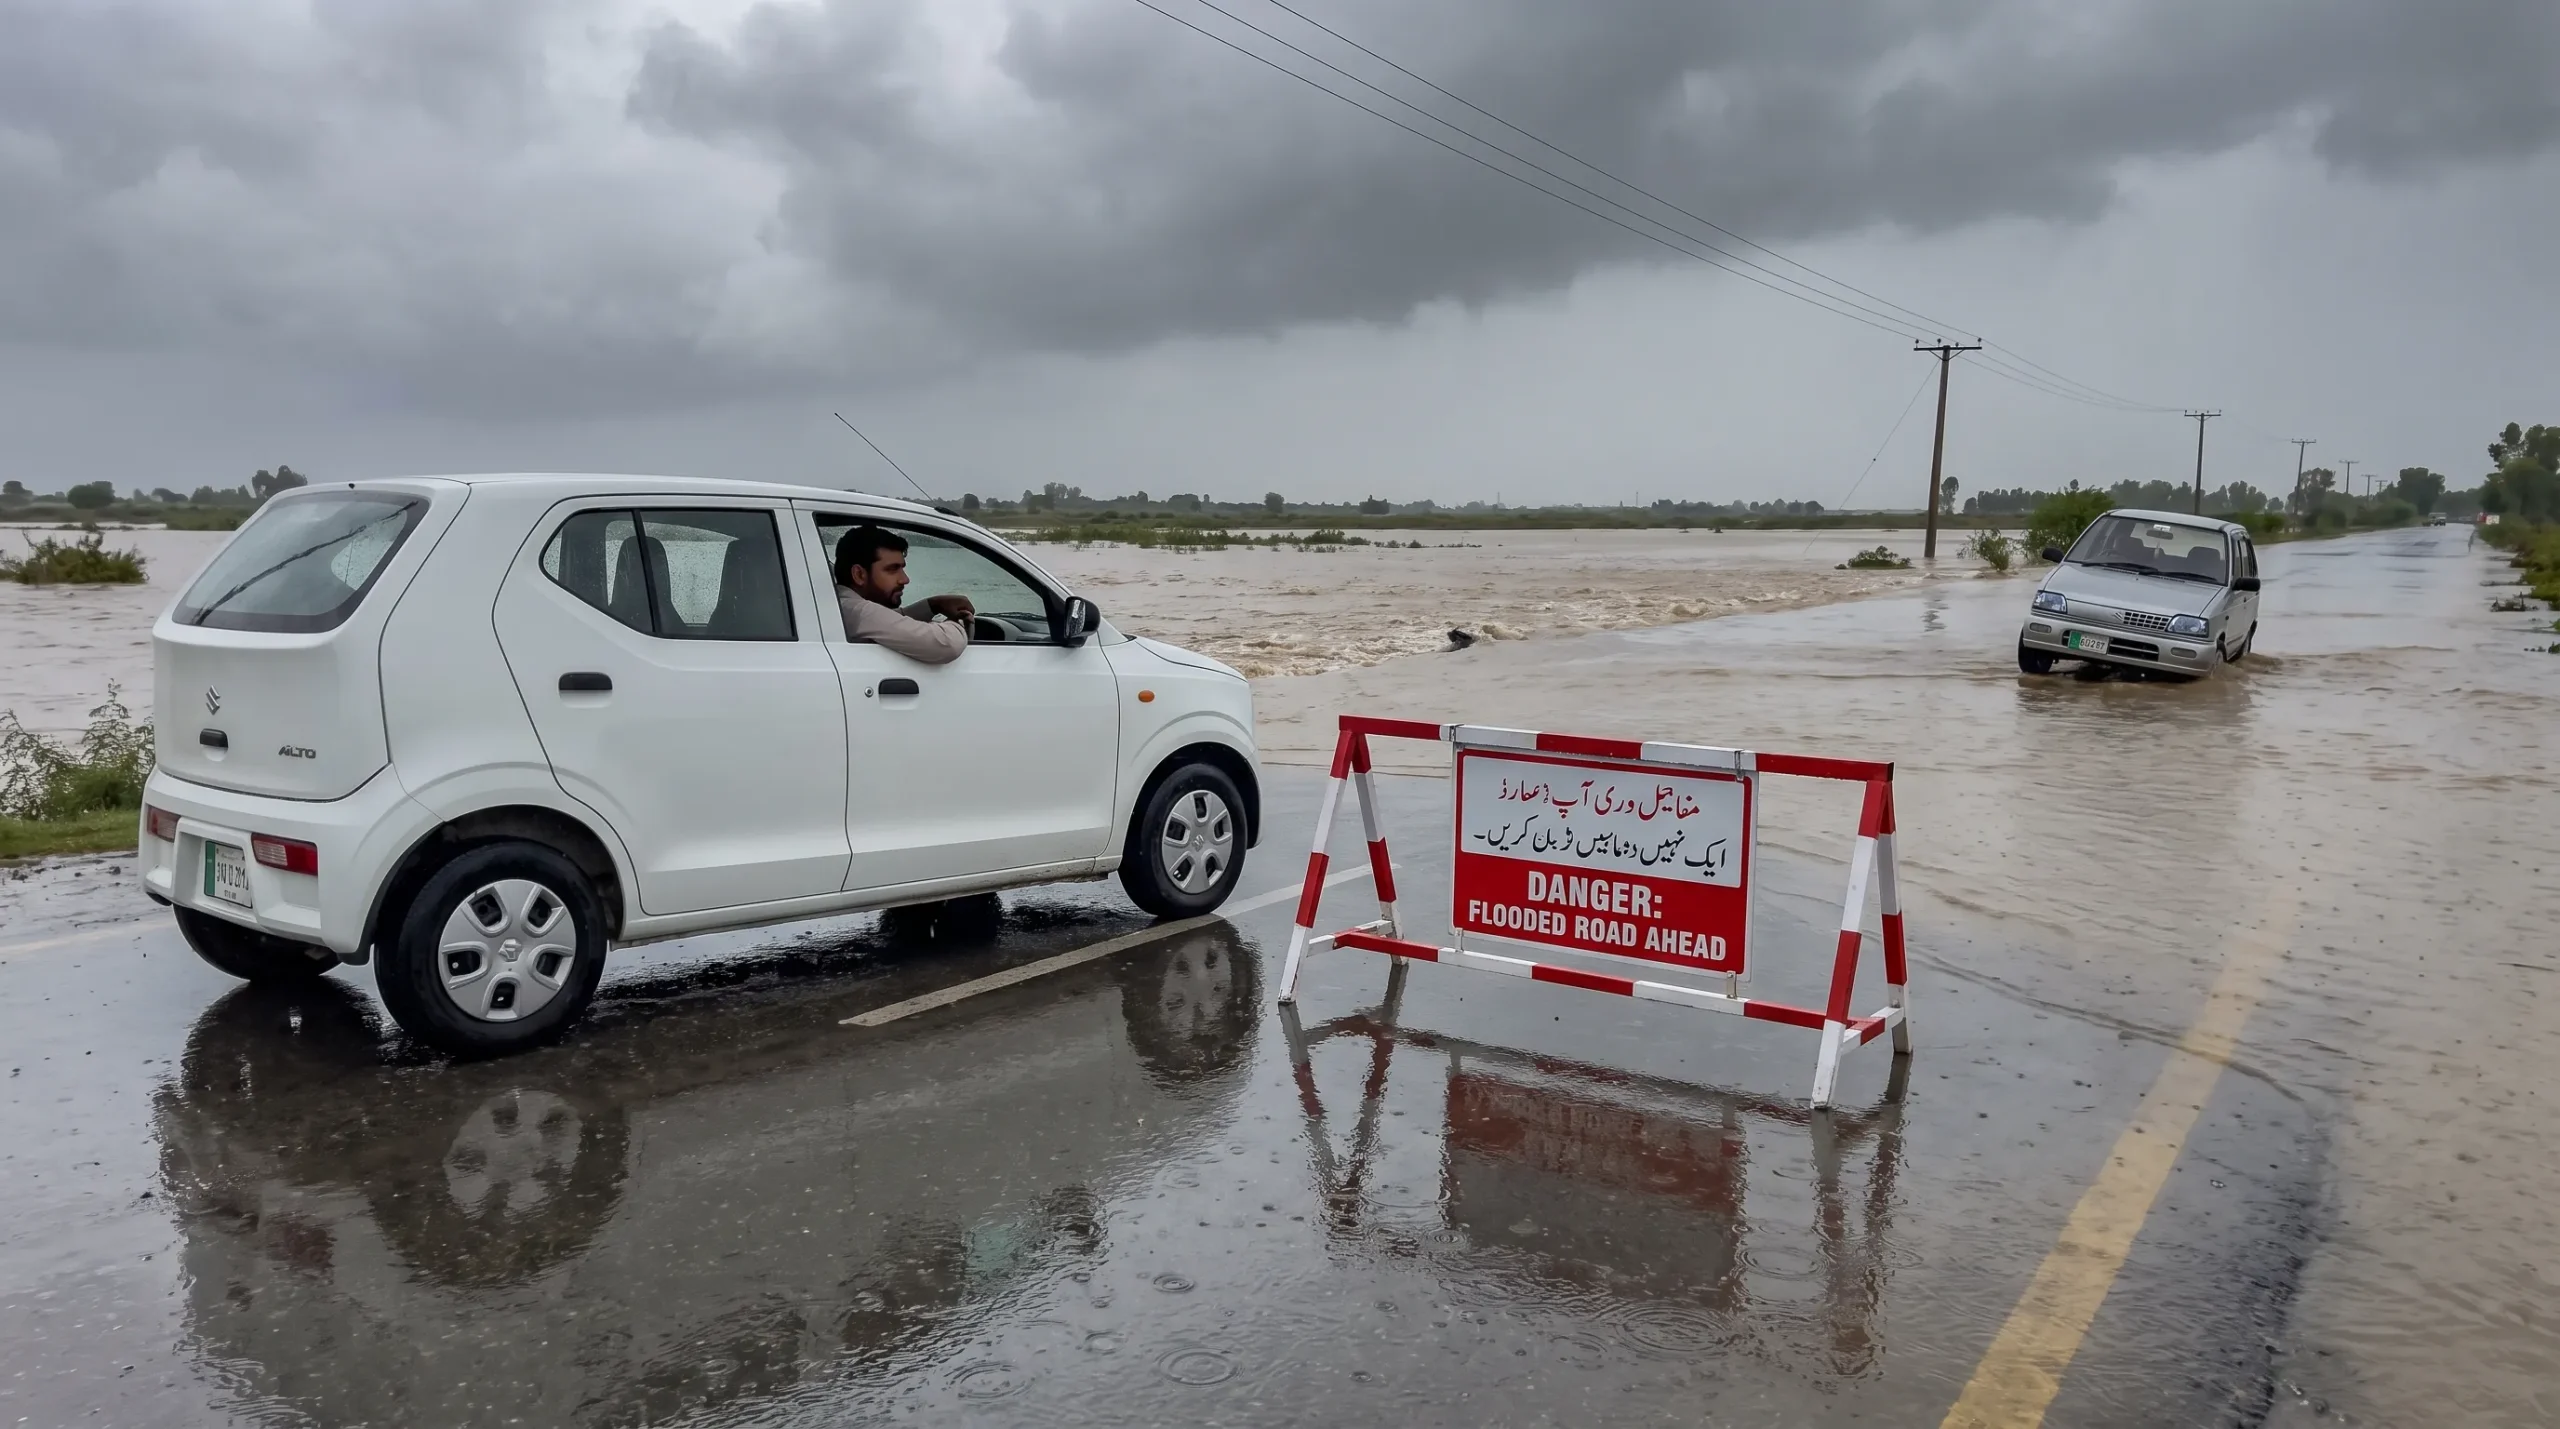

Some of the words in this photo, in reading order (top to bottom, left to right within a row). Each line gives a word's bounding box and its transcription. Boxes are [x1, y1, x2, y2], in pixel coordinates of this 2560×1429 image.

[1640, 829, 1685, 867] نہیں
[1684, 838, 1727, 877] ایک
[1528, 870, 1663, 919] DANGER:
[1468, 899, 1567, 936] FLOODED
[1574, 915, 1637, 947] ROAD
[1644, 926, 1727, 961] AHEAD
